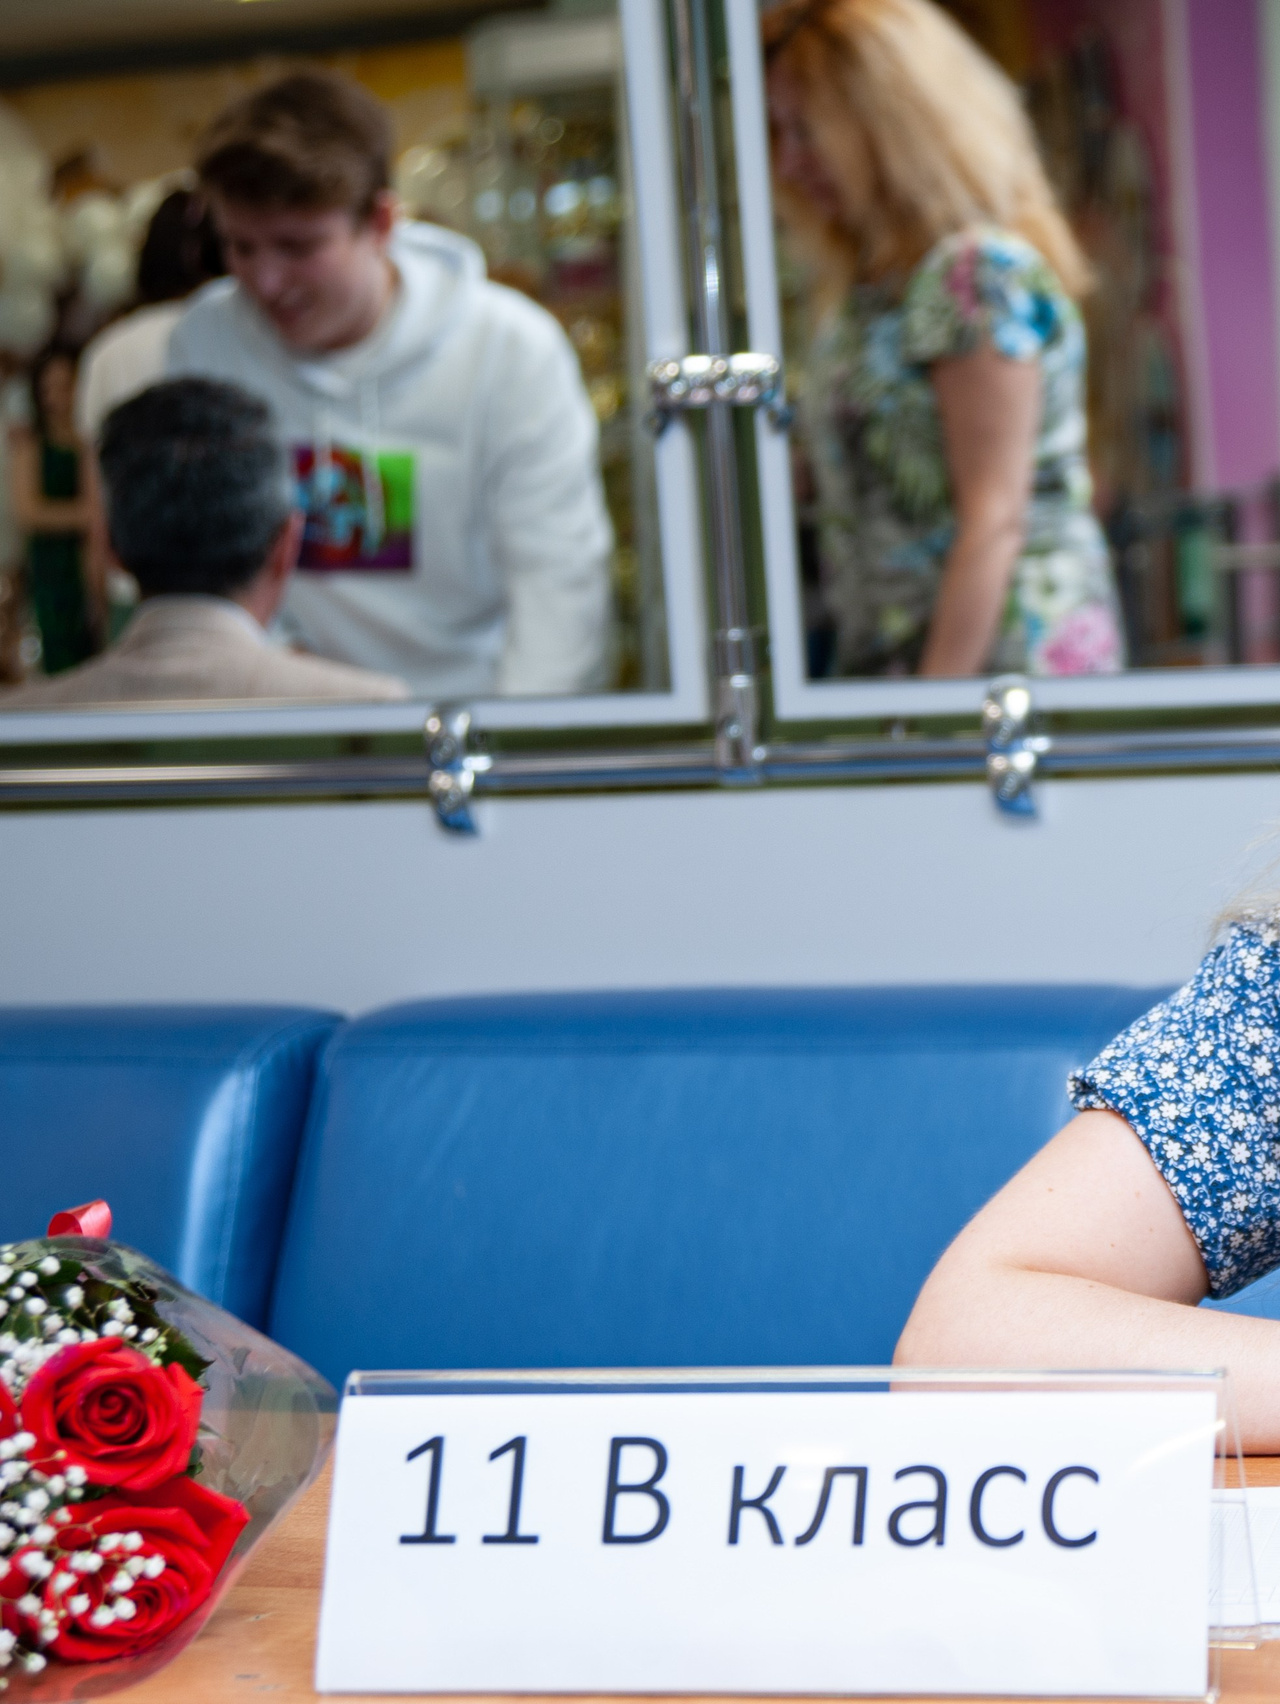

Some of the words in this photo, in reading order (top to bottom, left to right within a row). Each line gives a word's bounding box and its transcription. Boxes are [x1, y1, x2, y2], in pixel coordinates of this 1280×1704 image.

[398, 1435, 540, 1545] 11
[601, 1436, 671, 1546] В
[727, 1464, 1101, 1549] класс
